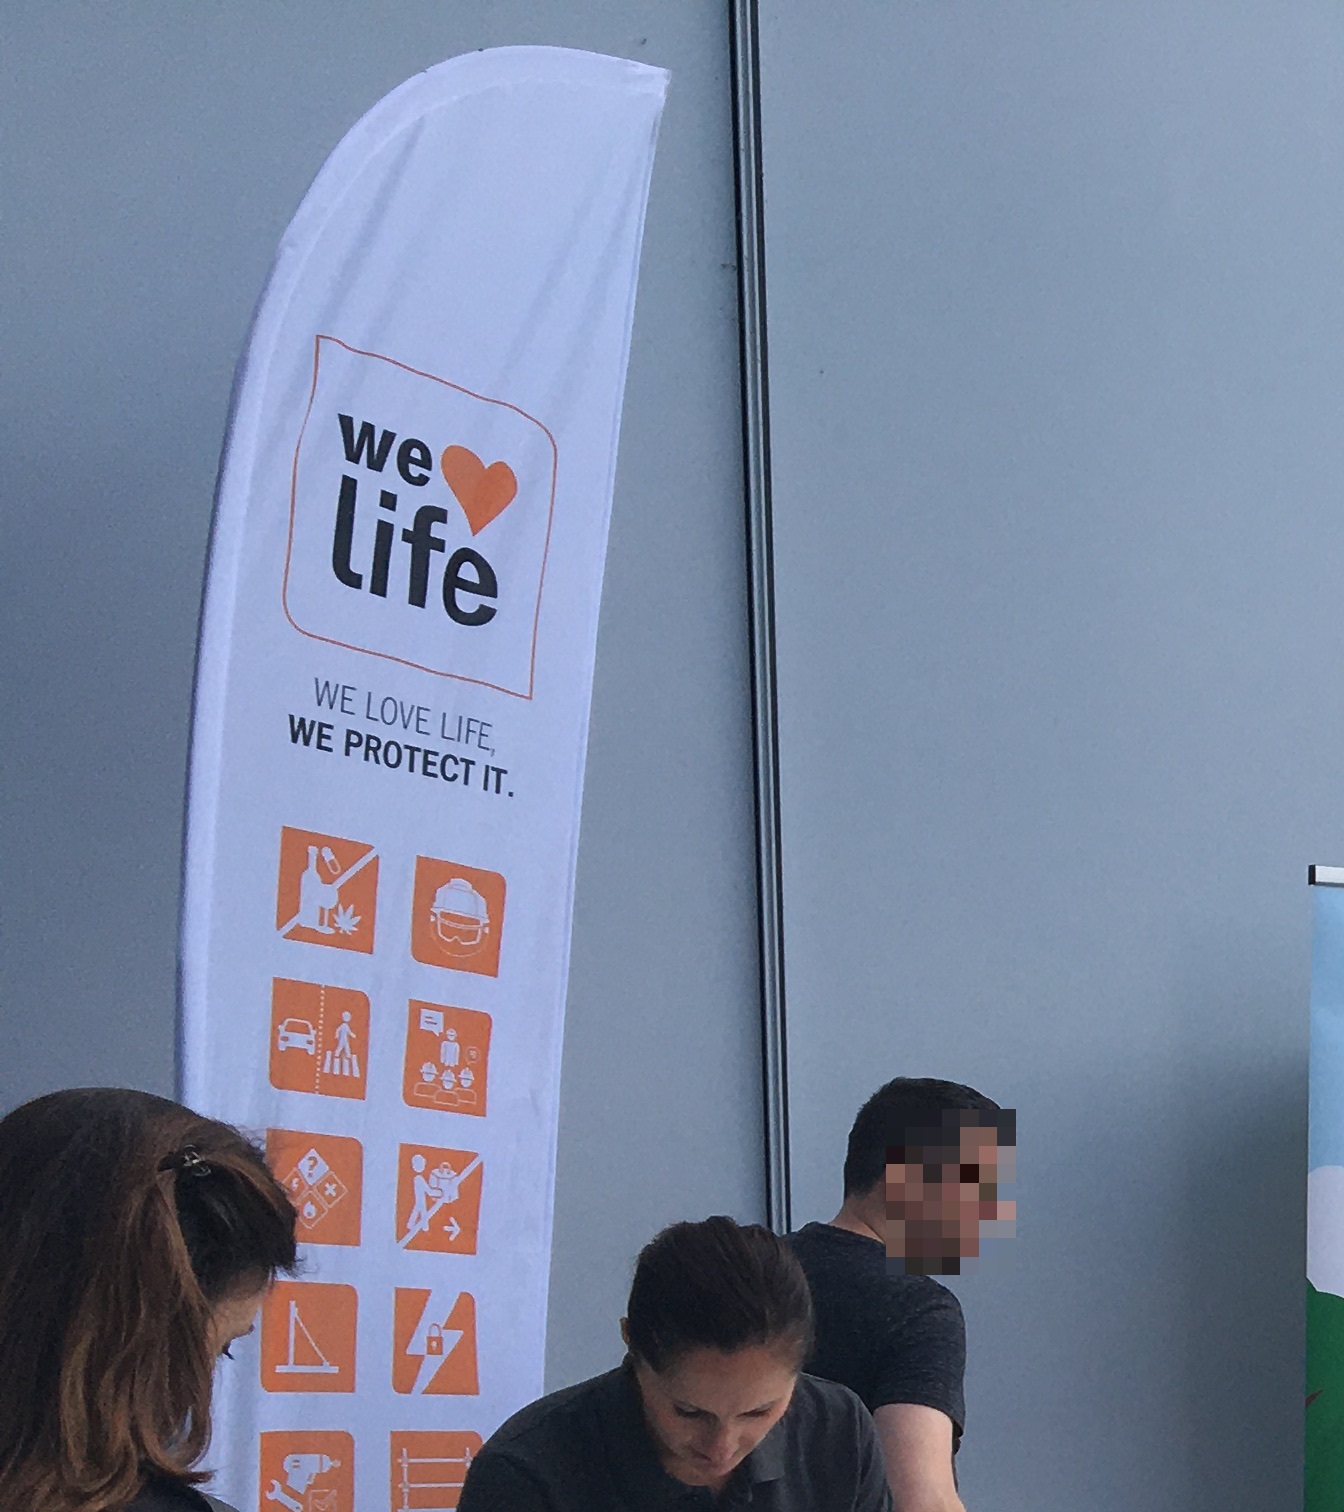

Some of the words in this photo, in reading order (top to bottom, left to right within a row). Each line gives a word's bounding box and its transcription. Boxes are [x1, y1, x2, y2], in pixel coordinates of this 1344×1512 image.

[337, 413, 433, 487] we
[332, 474, 499, 626] life
[288, 714, 334, 753] WE
[344, 730, 474, 786] PROTECT
[483, 766, 515, 797] IT.
[314, 677, 356, 715] WE
[366, 691, 431, 735] LOVE
[441, 711, 497, 757] LIFE,
